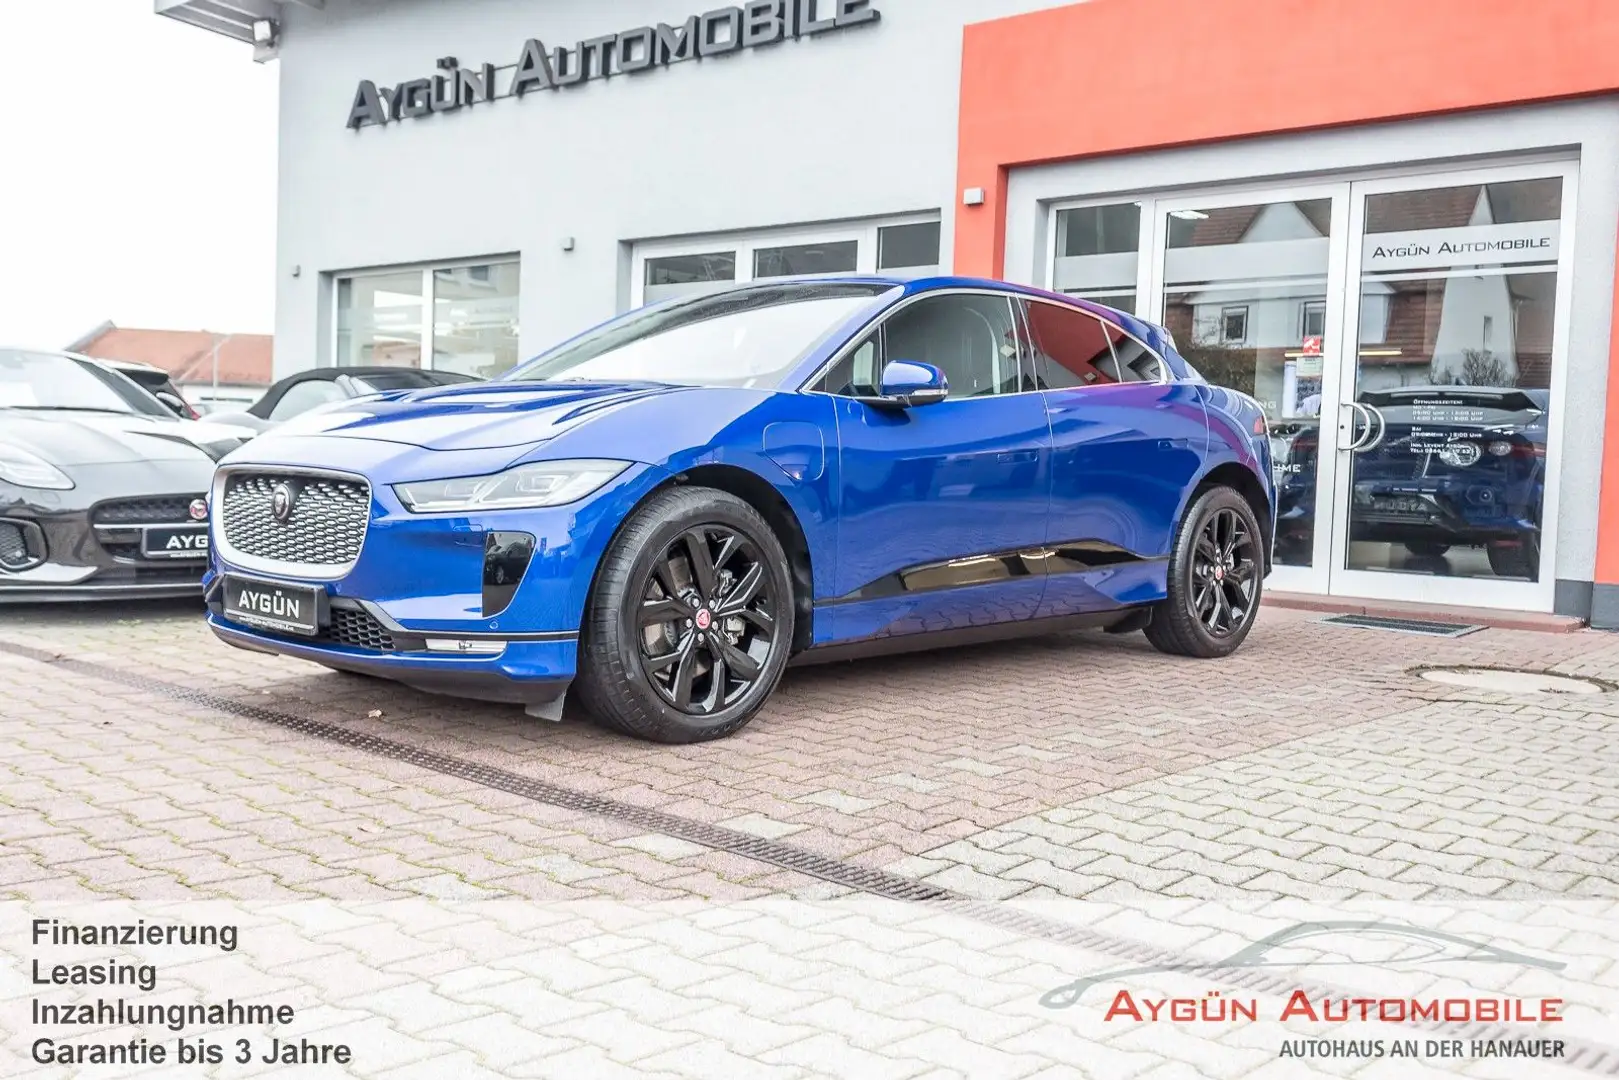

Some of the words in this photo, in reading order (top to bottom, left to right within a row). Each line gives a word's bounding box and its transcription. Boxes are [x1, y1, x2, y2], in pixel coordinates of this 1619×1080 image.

[346, 55, 495, 129] AYGÜN
[510, 0, 881, 97] AUTOMOBILE
[1372, 243, 1430, 259] AYGÜN
[1438, 237, 1551, 254] AUTOMOBILE
[166, 534, 209, 549] AYG
[238, 589, 300, 619] AYGÜN
